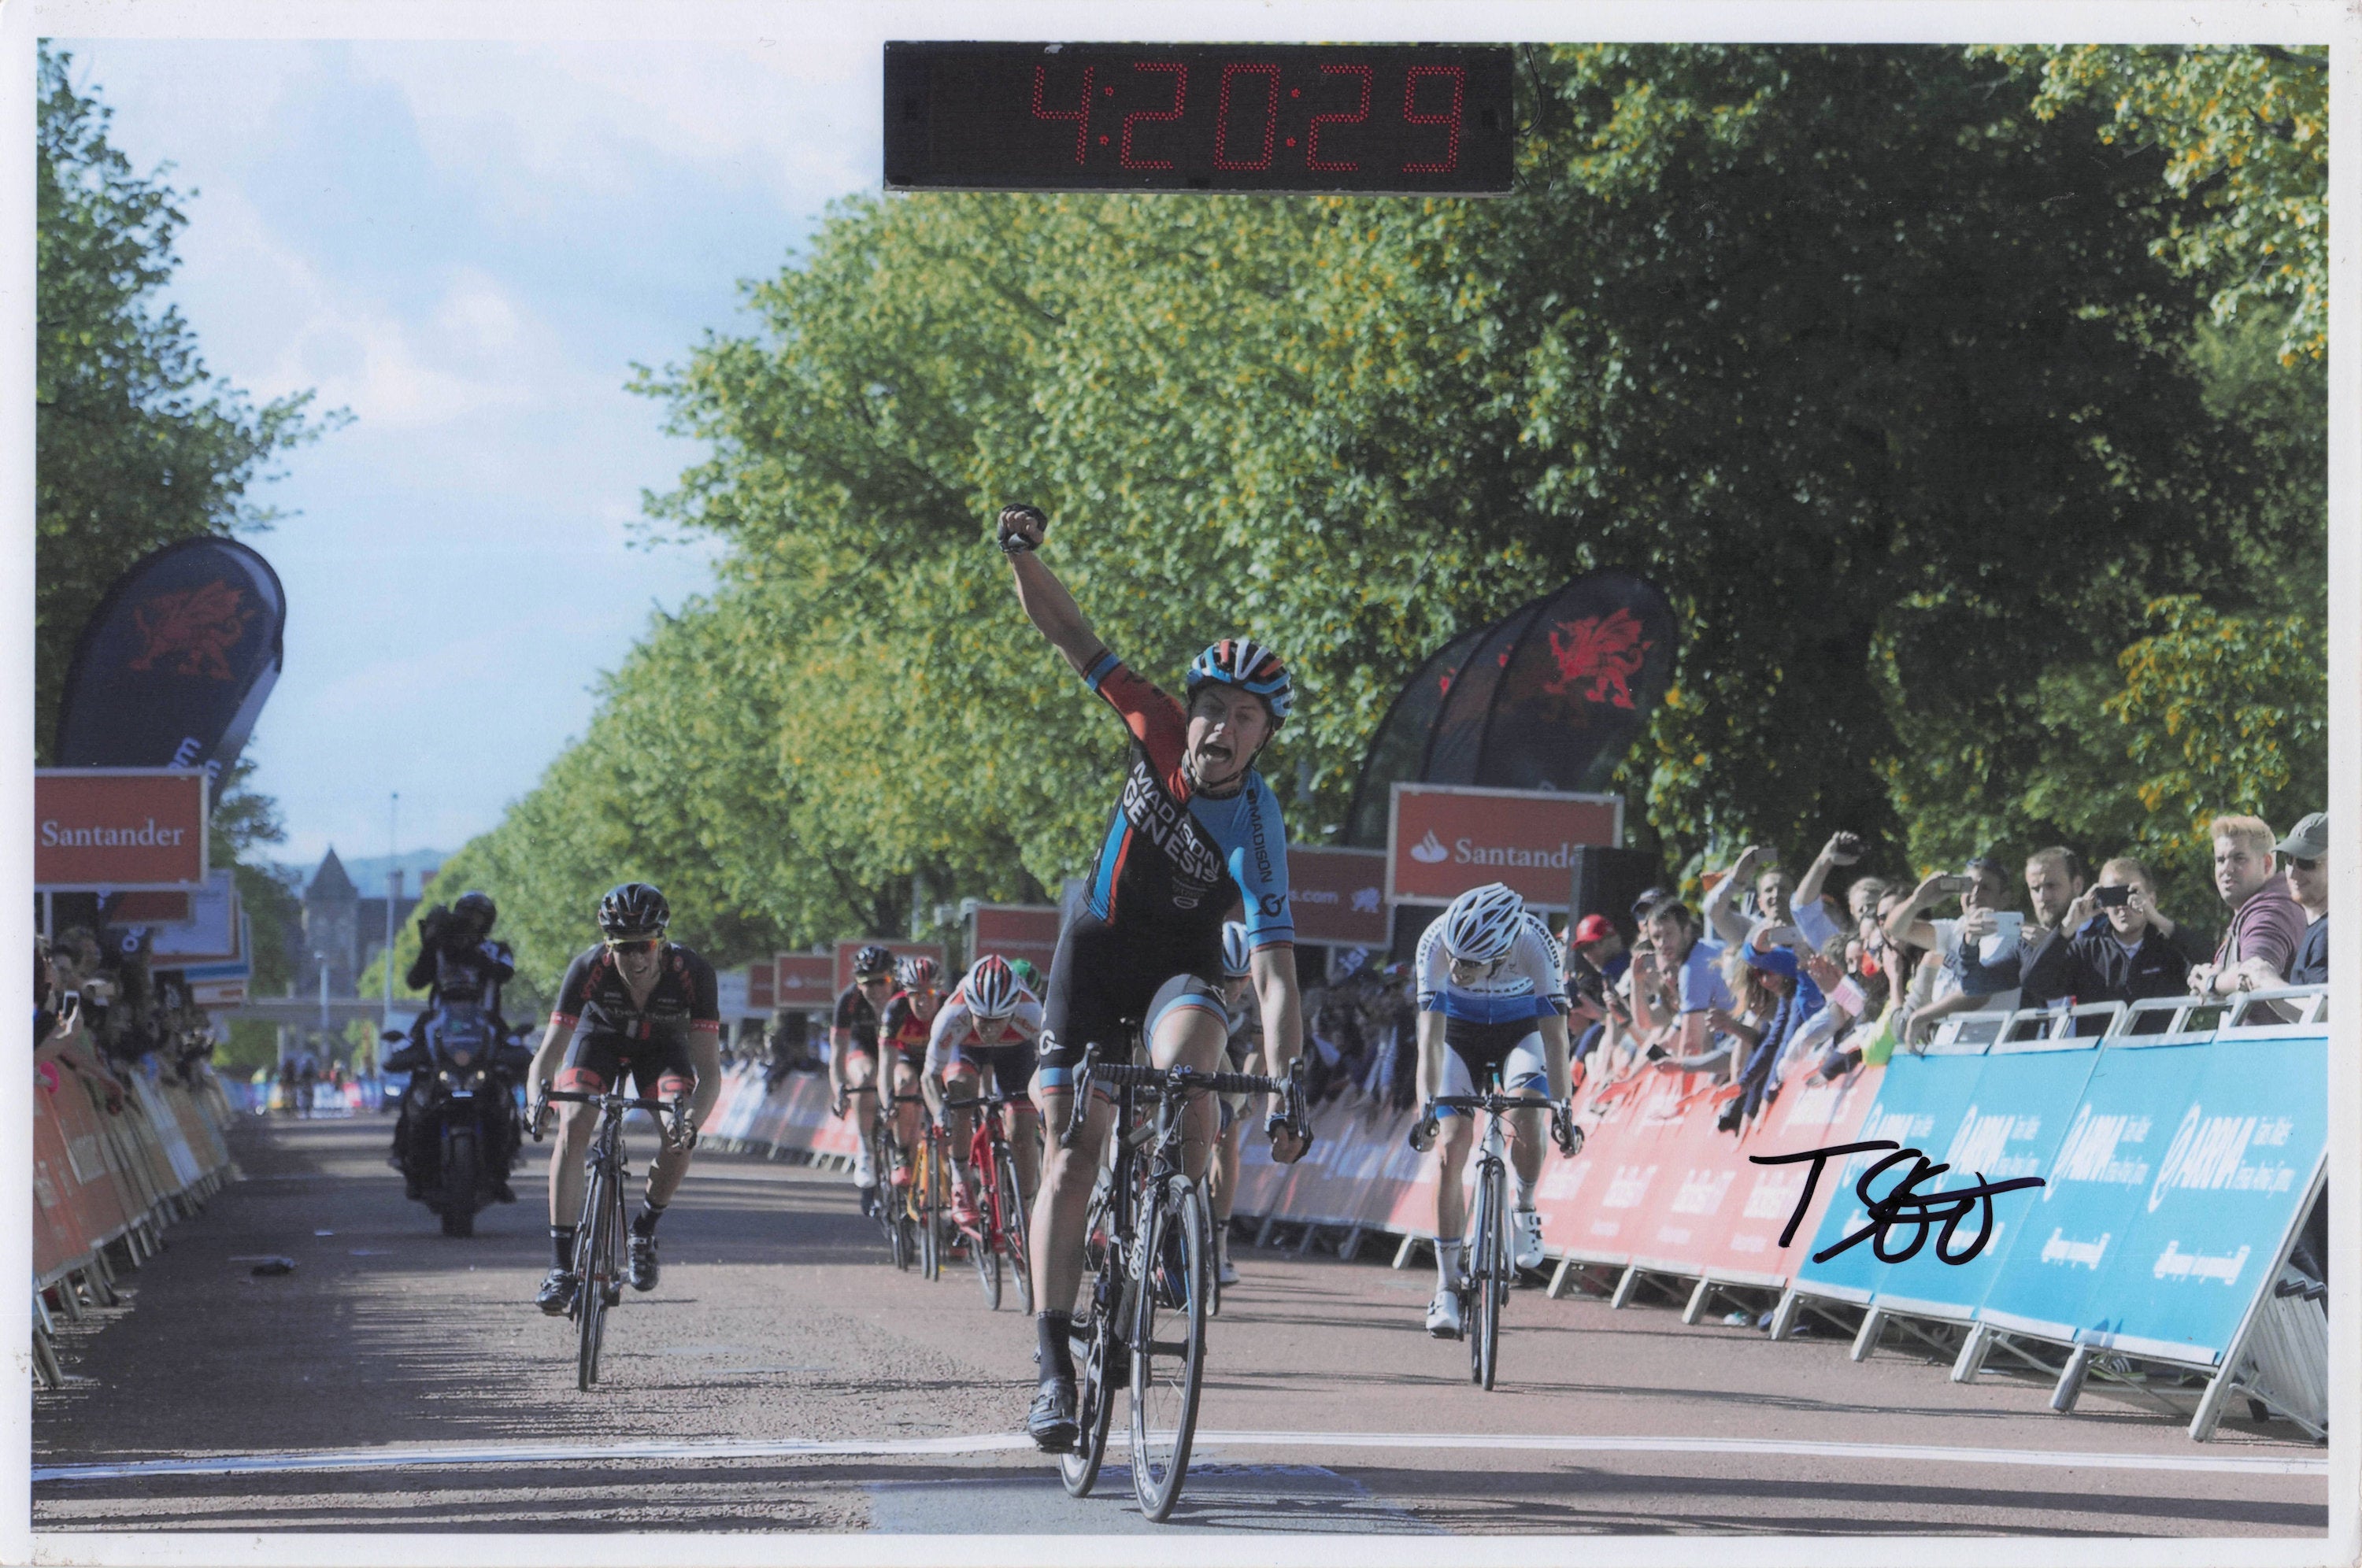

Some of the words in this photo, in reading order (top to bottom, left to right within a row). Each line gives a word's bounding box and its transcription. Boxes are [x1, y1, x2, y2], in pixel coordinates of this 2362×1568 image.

[1032, 62, 1465, 172] 4:20:29
[41, 818, 184, 848] Santander
[1124, 778, 1220, 882] GENESIS
[1134, 760, 1220, 875] MADISON
[1249, 807, 1273, 883] MADISON
[1455, 837, 1575, 868] Santand
